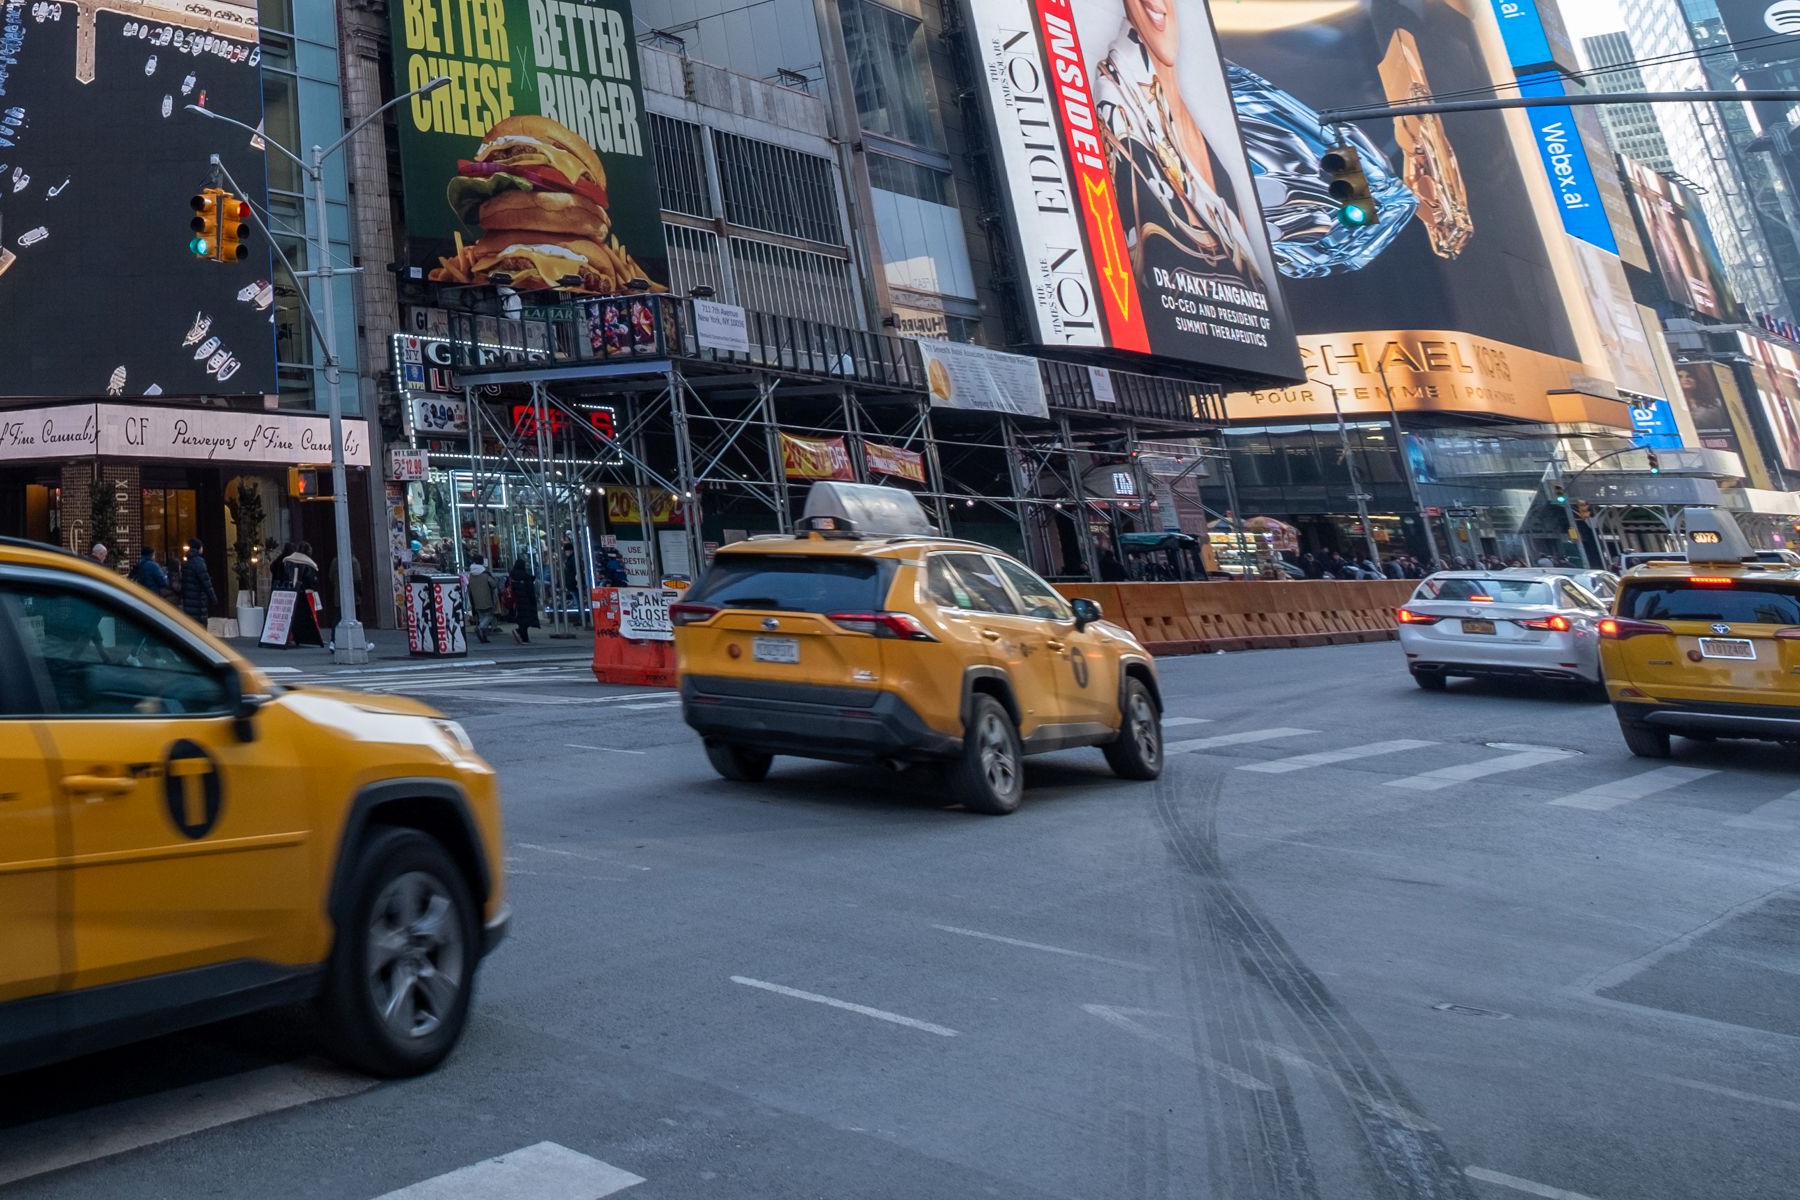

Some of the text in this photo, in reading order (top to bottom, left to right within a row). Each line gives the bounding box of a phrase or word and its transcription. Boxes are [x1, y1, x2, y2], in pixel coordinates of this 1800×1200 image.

[408, 53, 514, 137] CHEESE
[1045, 12, 1102, 169] INSIDE!
[537, 72, 643, 157] BURGER
[999, 29, 1071, 216] EDITION
[1542, 122, 1589, 209] Webex.ai
[1153, 267, 1269, 311] DR. MAKY ZANGANEH
[1161, 295, 1271, 330] CO-CEO AND PRESIDENT OF
[1176, 317, 1268, 348] SUMMIT THERAPEUTICS
[1255, 386, 1440, 404] POUR FEMME
[9, 422, 35, 445] Fine
[42, 415, 100, 444] Cannabis
[172, 419, 238, 460] Purveyors
[244, 424, 262, 452] of
[262, 426, 294, 451] Fine
[301, 428, 360, 456] Canbis
[115, 479, 129, 513] FOX
[627, 546, 642, 554] USE
[405, 583, 418, 651] CHICAGO
[434, 583, 448, 653] CHICAGO
[631, 608, 670, 621] CLOSE
[168, 755, 212, 823] T
